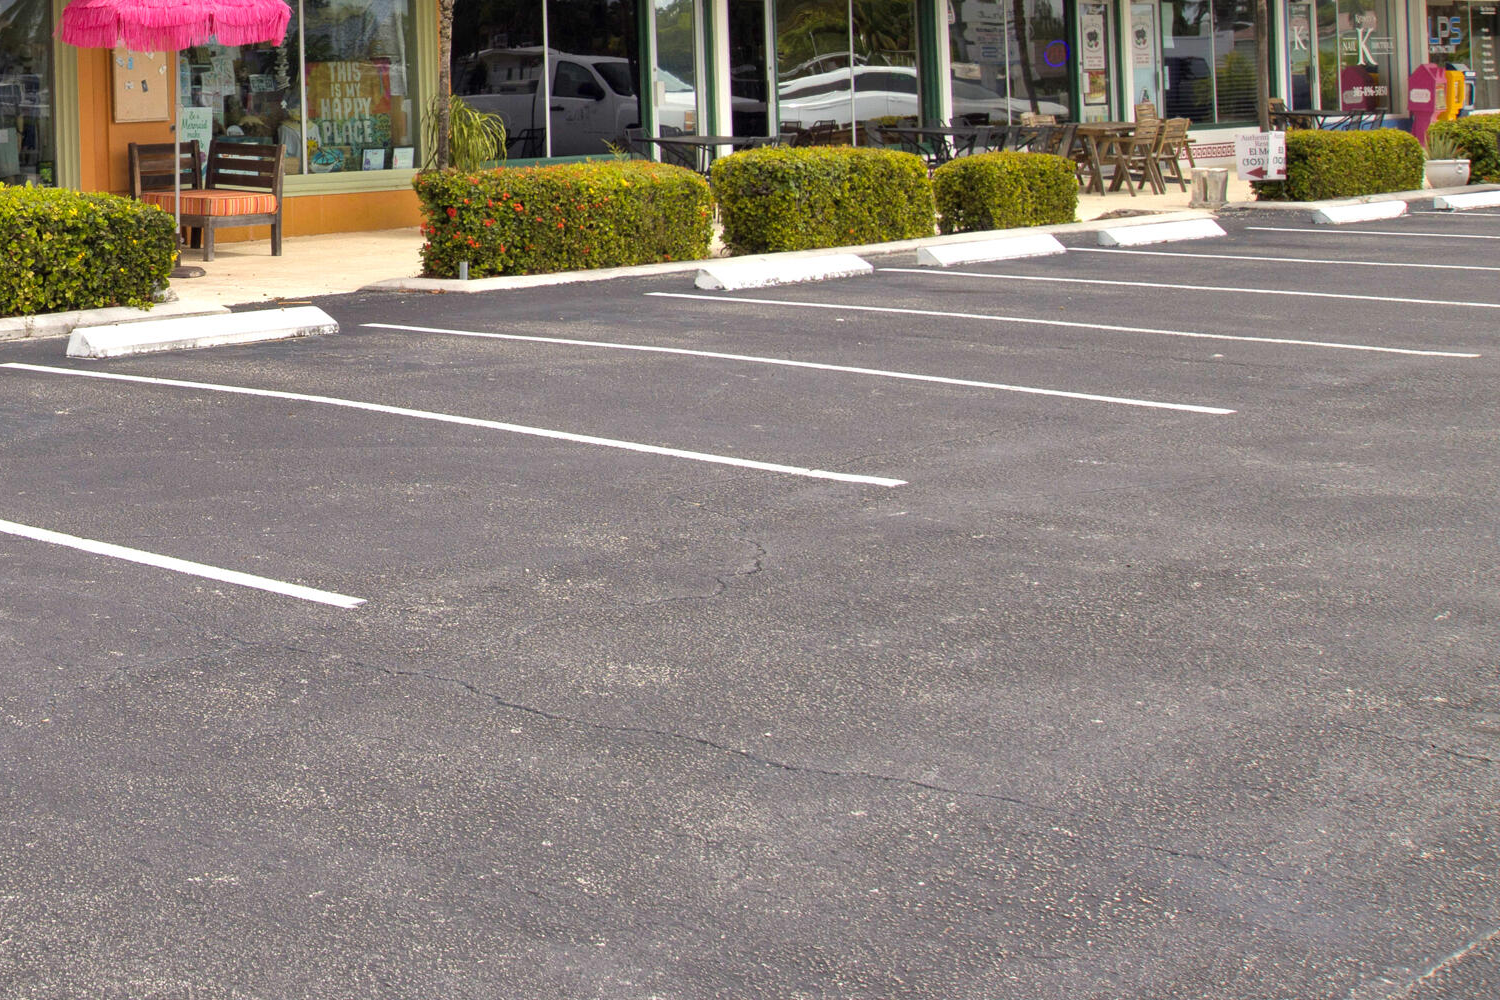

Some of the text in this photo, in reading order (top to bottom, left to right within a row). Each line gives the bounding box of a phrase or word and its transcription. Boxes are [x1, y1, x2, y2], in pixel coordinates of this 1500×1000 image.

[1293, 26, 1308, 50] K
[1427, 16, 1463, 45] LPS
[1356, 27, 1379, 66] K
[328, 62, 361, 82] THIS
[331, 82, 361, 97] IS MY
[321, 97, 372, 121] HAPPY
[182, 119, 208, 130] Mermaid
[323, 120, 373, 143] PLACE
